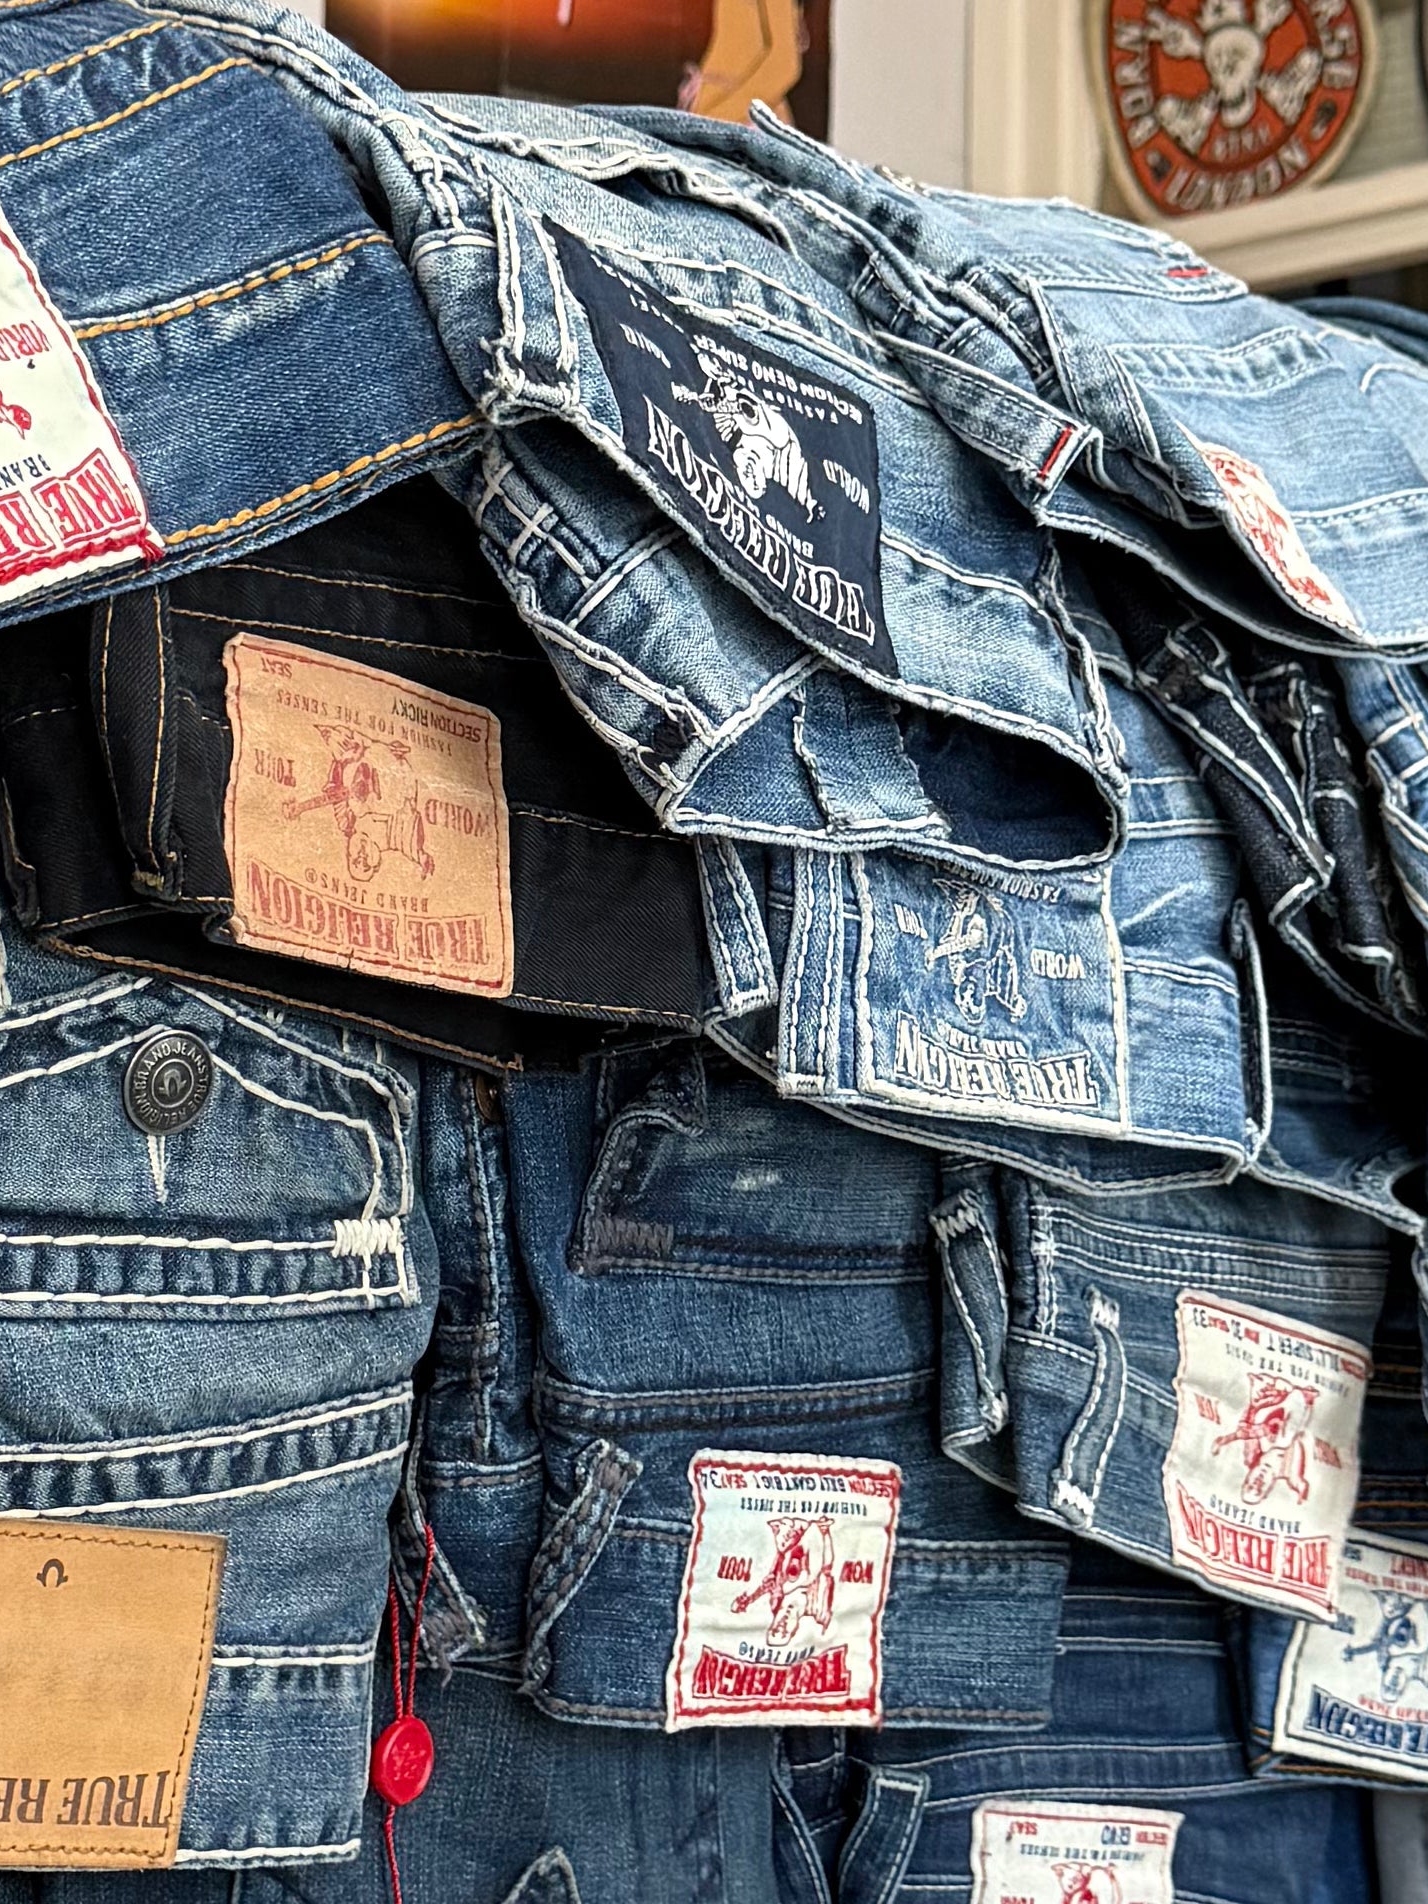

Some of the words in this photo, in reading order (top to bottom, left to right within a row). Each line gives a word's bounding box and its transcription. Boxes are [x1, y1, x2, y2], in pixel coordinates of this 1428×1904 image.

[1114, 19, 1161, 149] BORN
[823, 459, 871, 515] WORLD
[260, 657, 292, 677] SEAT
[275, 687, 328, 716] SENSES
[333, 704, 360, 726] THE
[390, 698, 432, 727] RICKY
[367, 714, 395, 735] FOR
[429, 713, 482, 742] SECTION
[253, 747, 297, 787] TOUR
[421, 798, 488, 838] WORLD
[241, 862, 398, 952] RELIGION
[374, 891, 429, 913] BRAND
[403, 908, 489, 965] TRUE
[1027, 947, 1088, 982] WORLD
[56, 1769, 170, 1829] TRUE
